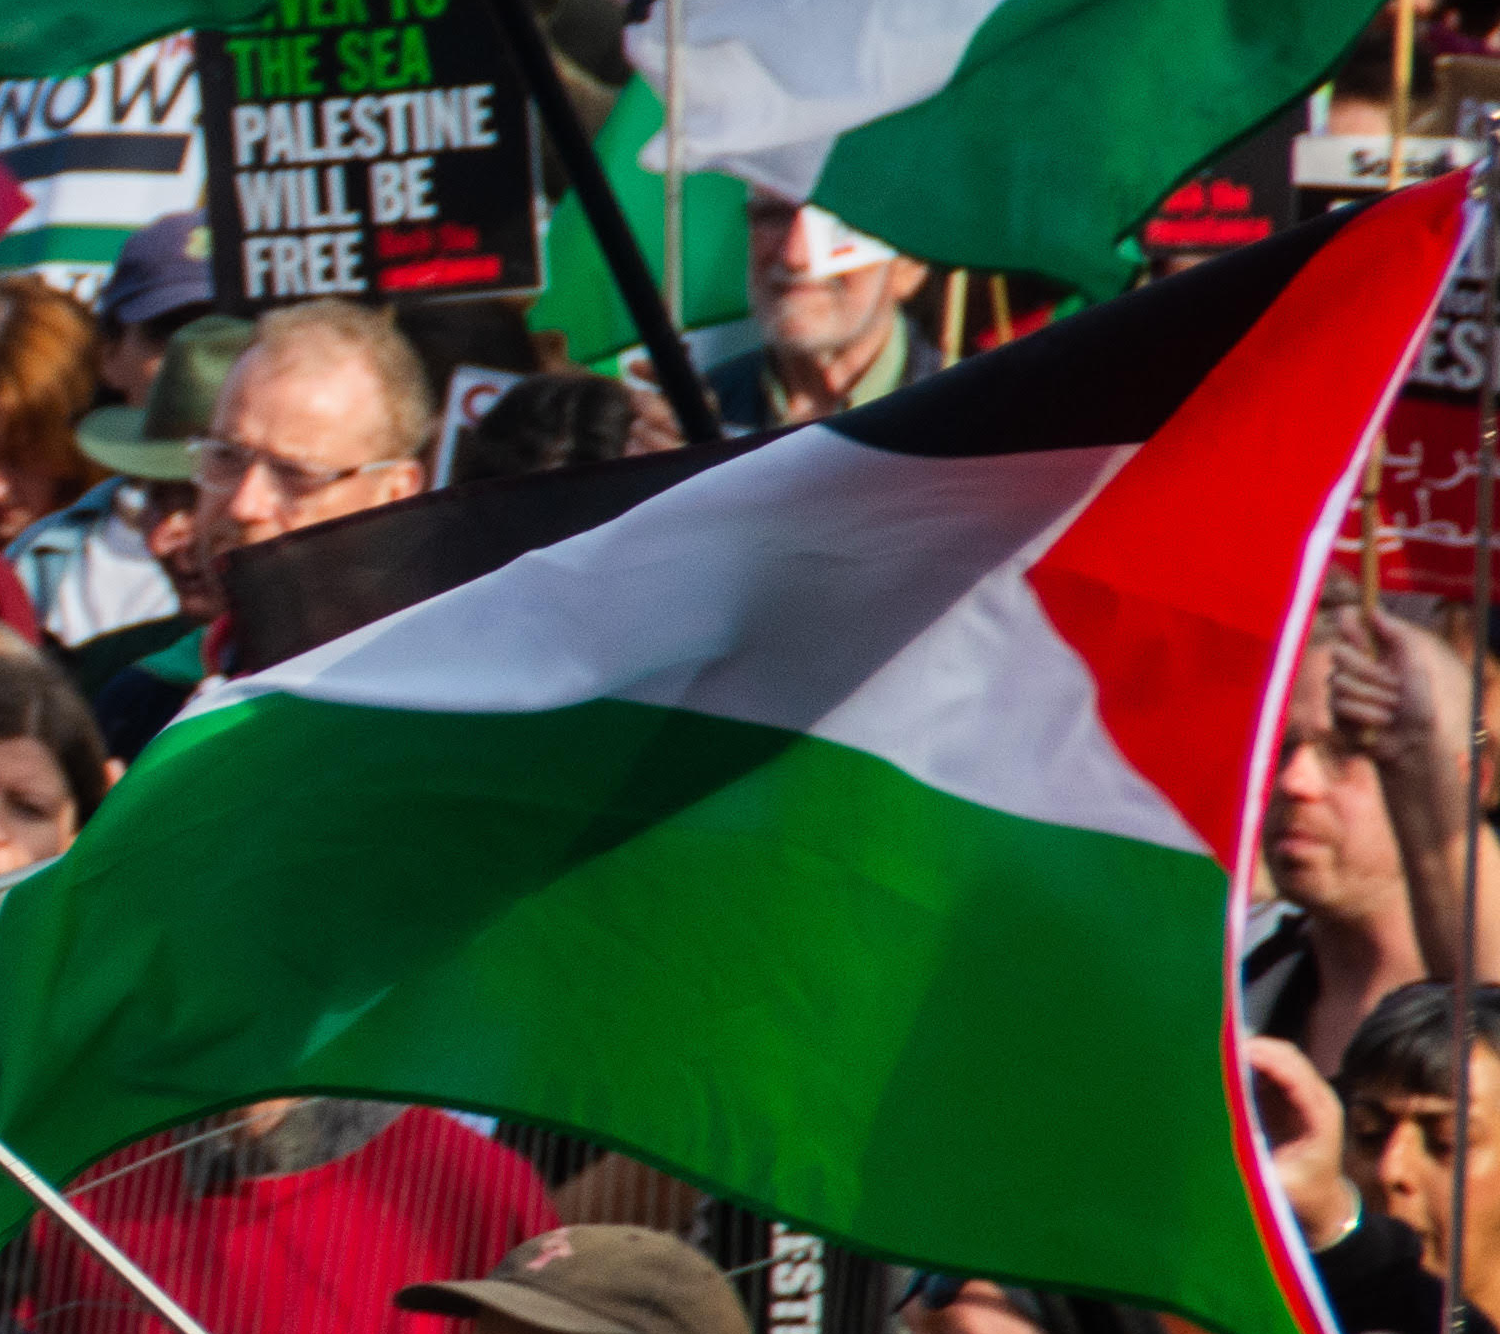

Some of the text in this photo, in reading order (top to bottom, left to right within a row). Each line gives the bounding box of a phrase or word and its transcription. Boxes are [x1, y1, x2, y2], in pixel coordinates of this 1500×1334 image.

[225, 24, 434, 99] THE SEA
[231, 83, 499, 166] PALESTINE
[235, 157, 440, 242] WILL BE
[243, 232, 369, 298] FREE
